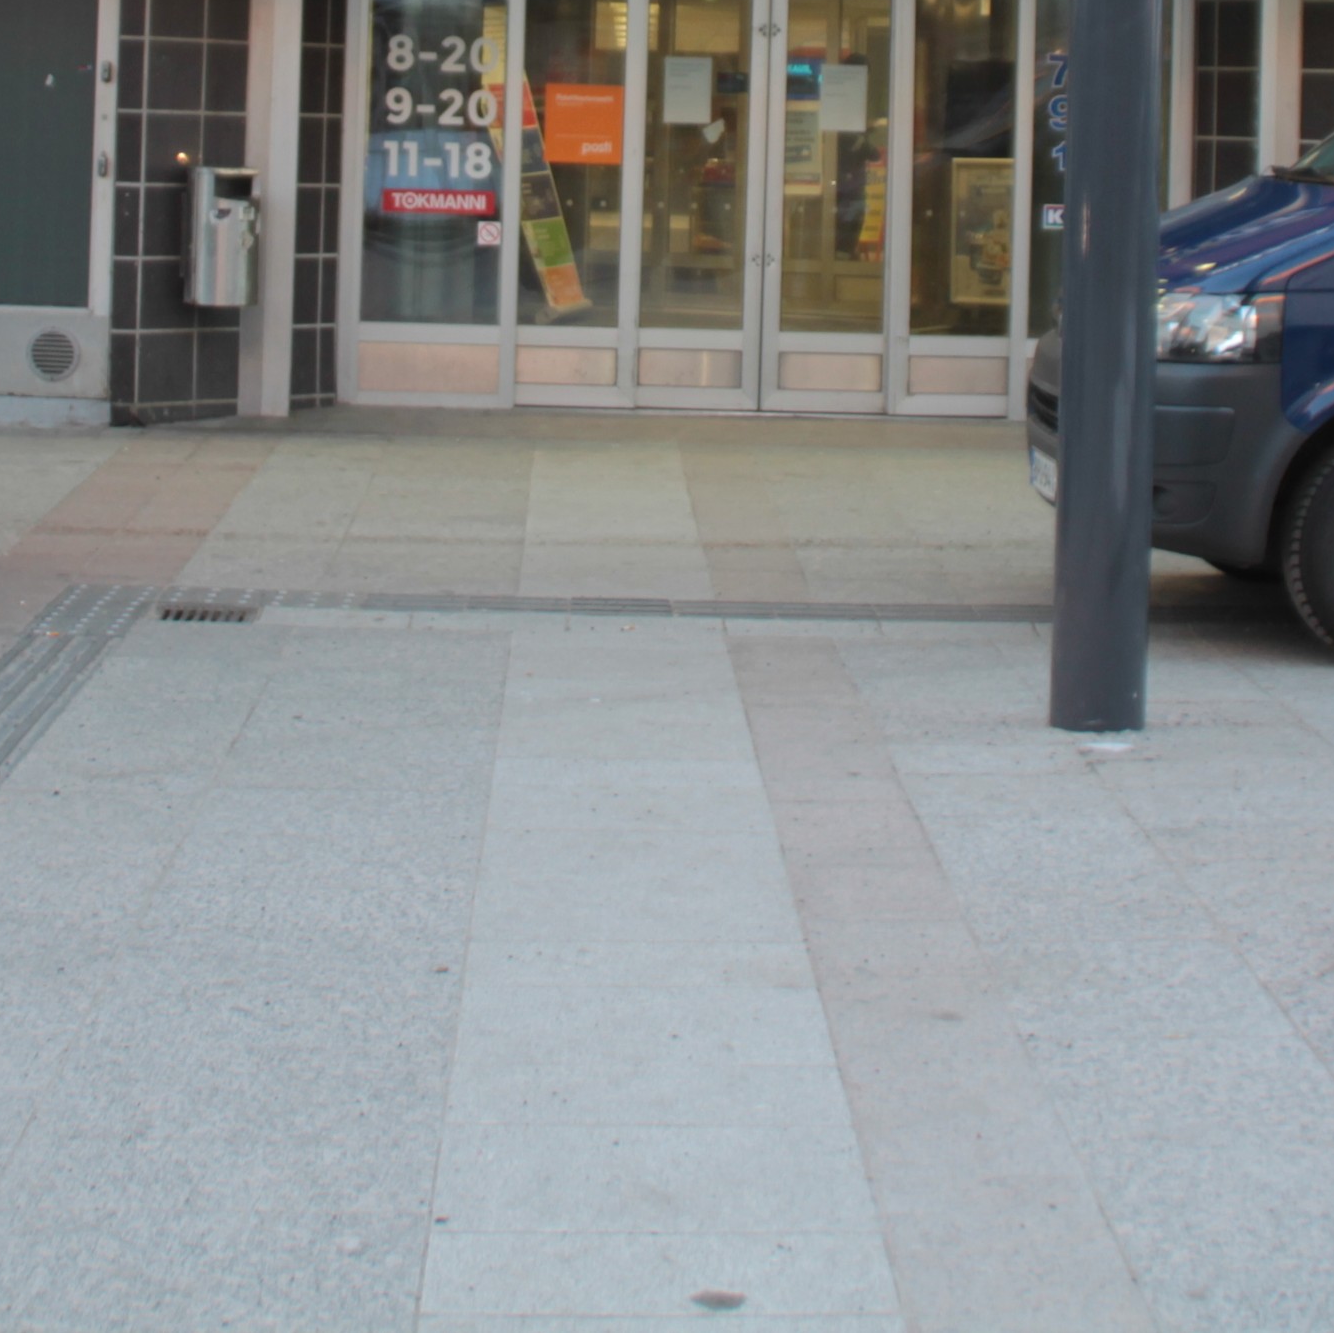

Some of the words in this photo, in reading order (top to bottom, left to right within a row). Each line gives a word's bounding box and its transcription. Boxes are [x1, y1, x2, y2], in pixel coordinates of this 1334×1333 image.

[386, 34, 500, 74] 8-20
[385, 86, 498, 127] 9-20
[382, 140, 493, 180] 11-18
[391, 192, 487, 212] TOKMANNI
